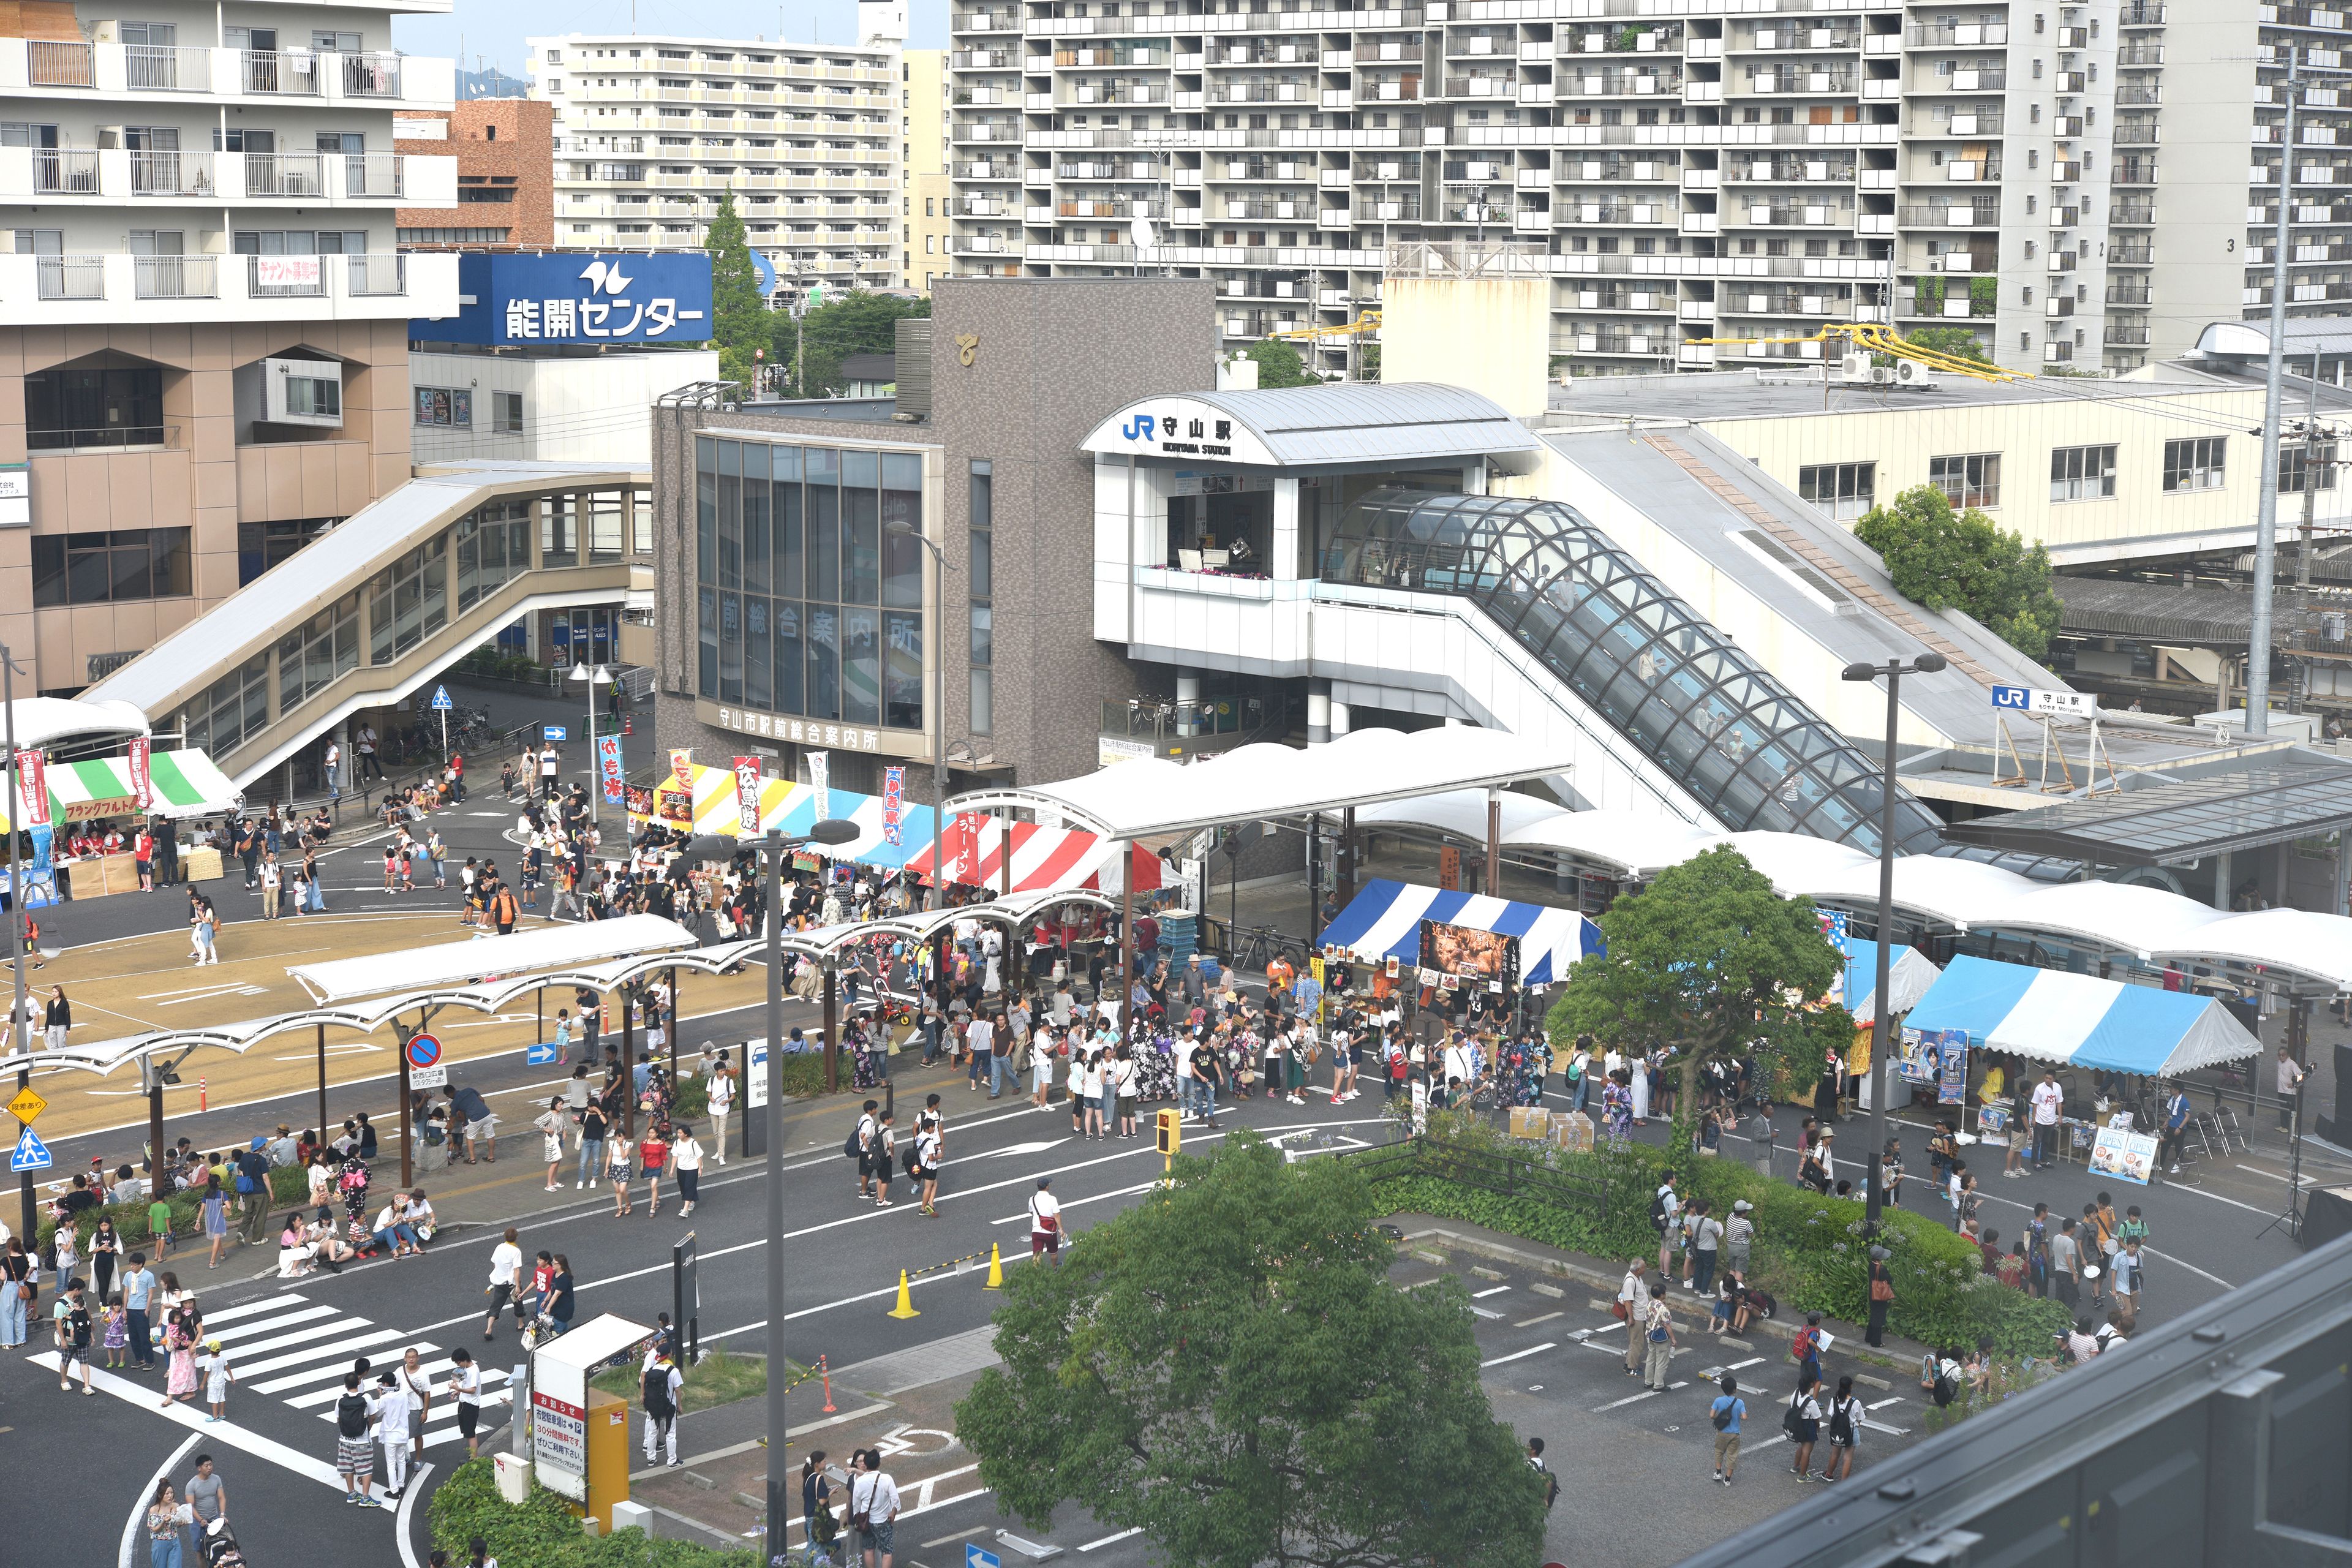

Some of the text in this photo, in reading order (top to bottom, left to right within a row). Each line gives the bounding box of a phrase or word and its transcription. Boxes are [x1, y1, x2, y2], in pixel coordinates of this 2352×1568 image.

[2100, 242, 2104, 257] 2
[2227, 238, 2234, 252] 3
[260, 262, 318, 281] テナント募集中
[507, 298, 703, 338] 能開センター
[1123, 415, 1155, 441] JR
[1163, 417, 1231, 440] 守山駅
[1163, 442, 1231, 456] MORIYAMA STATION
[1999, 690, 2024, 707] JR
[2043, 694, 2079, 706] 守山駅
[720, 709, 878, 750] 守山市駅前総合案内所
[1101, 739, 1153, 754] 守山市駅前総合案内所
[736, 764, 758, 831] 広島焼
[886, 780, 899, 824] かき氷
[67, 801, 130, 818] フランクフルト
[957, 820, 969, 874] ラーメン
[1432, 924, 1509, 949] 近江とり唐揚げ
[1945, 1050, 1961, 1071] 7
[412, 1070, 444, 1080] 駅西口広場
[750, 1080, 768, 1088] 一般車
[2098, 1135, 2124, 1147] OPEN
[2129, 1142, 2154, 1153] OPEN
[541, 1396, 575, 1415] お知らせ
[537, 1409, 567, 1428] 市営駐車場は
[537, 1425, 582, 1449] 30分間無料です。
[537, 1437, 582, 1462] ぜひご利用下さい。
